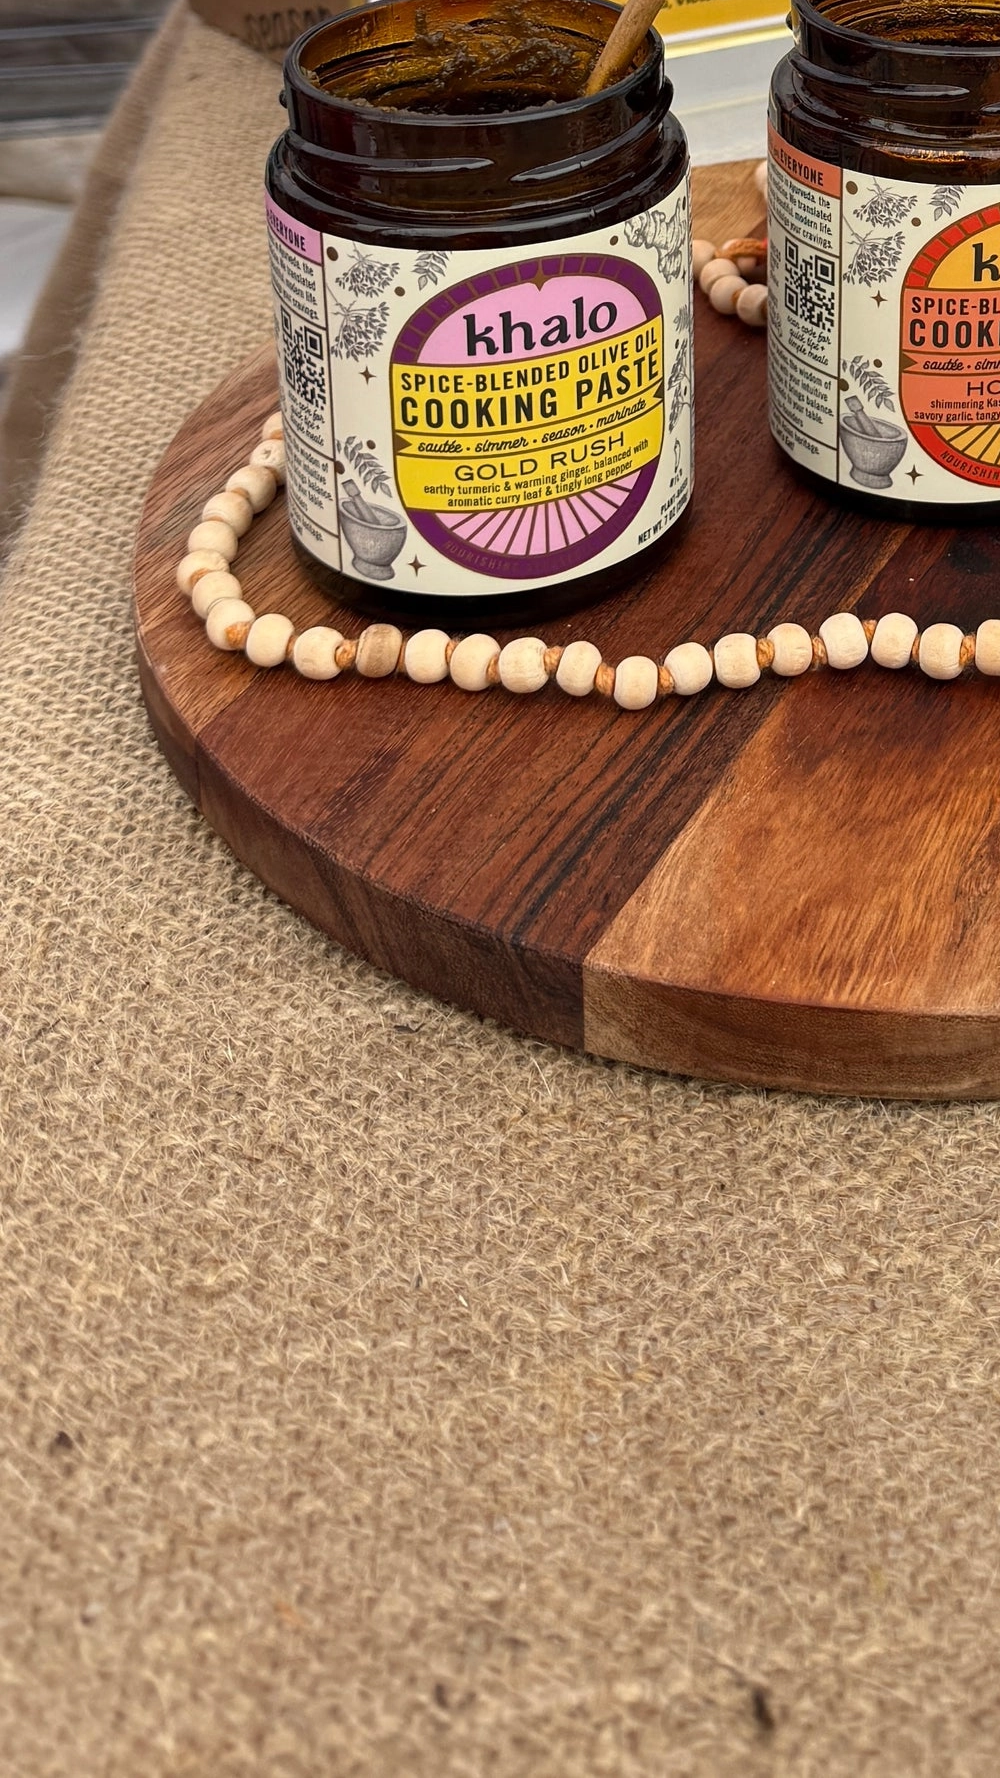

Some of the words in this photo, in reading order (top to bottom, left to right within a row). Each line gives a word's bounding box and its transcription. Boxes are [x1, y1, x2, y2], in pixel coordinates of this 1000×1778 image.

[780, 148, 824, 187] EVERYONE
[463, 295, 618, 357] khalo
[401, 359, 569, 394] SPICE-BLENDED
[578, 340, 629, 374] OLIVE
[634, 326, 658, 354] OIL
[400, 386, 557, 429] COOKING
[575, 347, 659, 410] PASTE
[930, 399, 984, 411] shimmering
[417, 439, 463, 453] sautée
[474, 435, 529, 453] simmer
[541, 424, 588, 443] season
[596, 399, 647, 429] marinate
[914, 409, 943, 423] savory
[423, 483, 455, 497] earthy
[457, 482, 501, 495] turmeric
[514, 473, 558, 490] warming
[593, 446, 632, 471] balanced
[454, 458, 538, 481] GOLD
[550, 430, 624, 470] RUSH
[447, 494, 493, 507] aromatic
[495, 490, 521, 504] curry
[523, 488, 543, 501] leaf
[584, 472, 603, 486] long
[605, 460, 633, 480] pepper
[638, 527, 652, 545] NET
